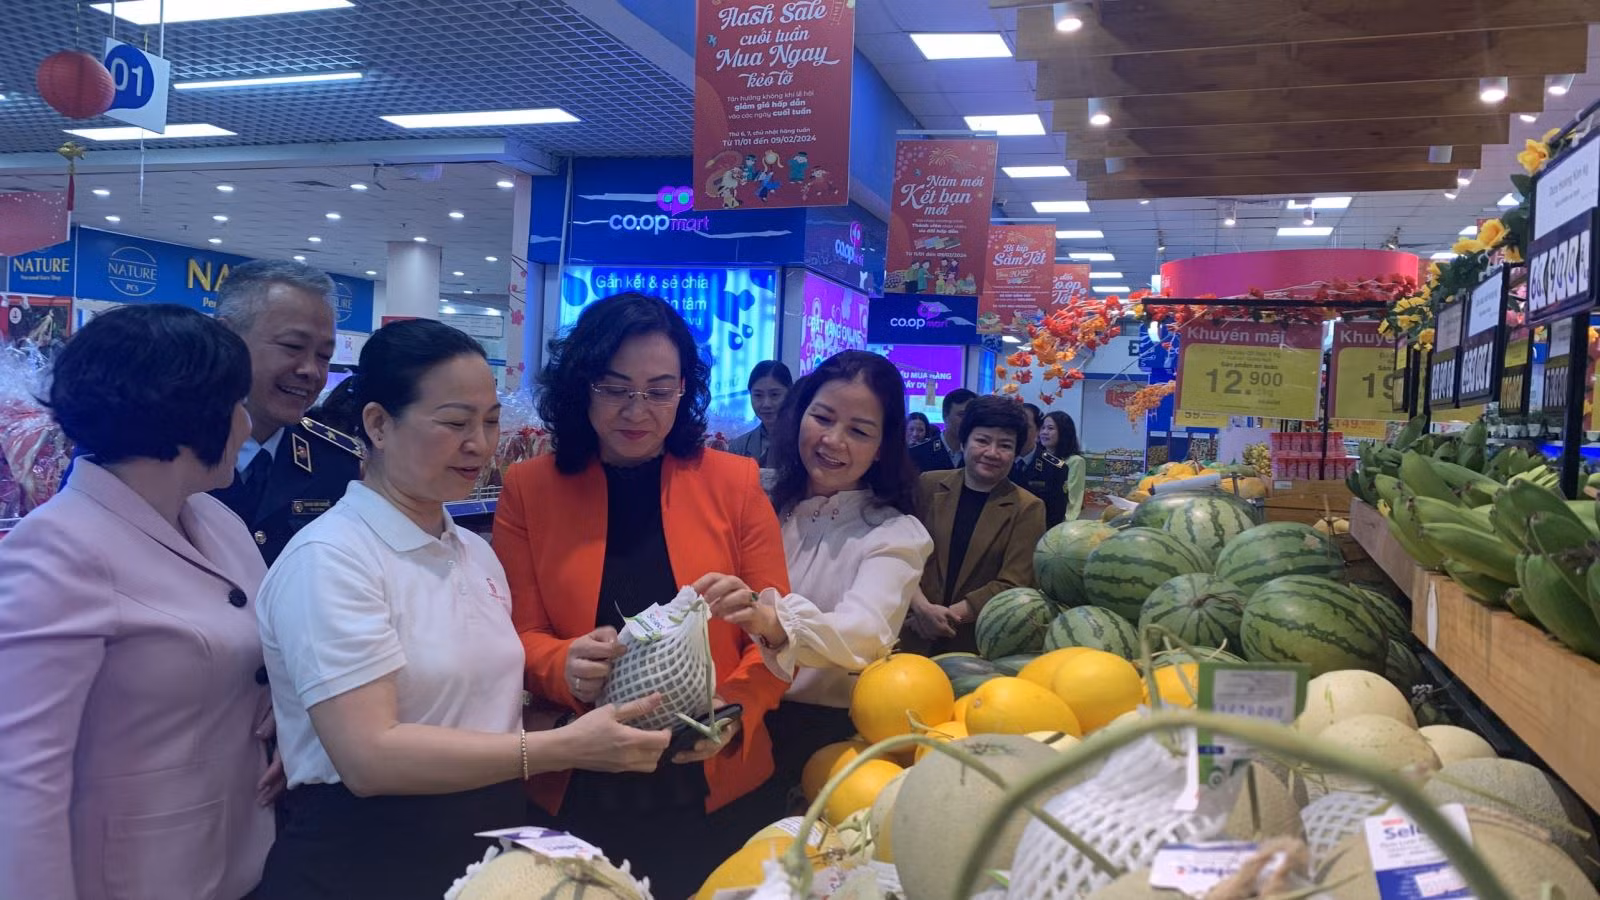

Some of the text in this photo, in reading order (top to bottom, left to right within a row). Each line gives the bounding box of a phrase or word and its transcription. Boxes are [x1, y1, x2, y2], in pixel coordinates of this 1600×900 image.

[718, 1, 828, 30] Flash Sale
[740, 25, 810, 46] cuối tuần
[716, 45, 840, 72] Mua Ngay
[110, 58, 144, 96] 01
[738, 70, 794, 88] kẻo lỡ
[770, 134, 816, 144] 09/02/2024
[926, 175, 984, 188] Năm mới
[900, 184, 972, 210] Kết bạn
[924, 204, 950, 216] mới
[14, 258, 70, 272] NATURE
[992, 250, 1046, 266] Sắm Tết
[108, 262, 158, 281] NATURE
[626, 272, 646, 288] kết
[648, 276, 658, 288] &
[682, 275, 709, 288] chia
[682, 296, 706, 310] tâm
[1187, 326, 1285, 344] Khuyến mãi
